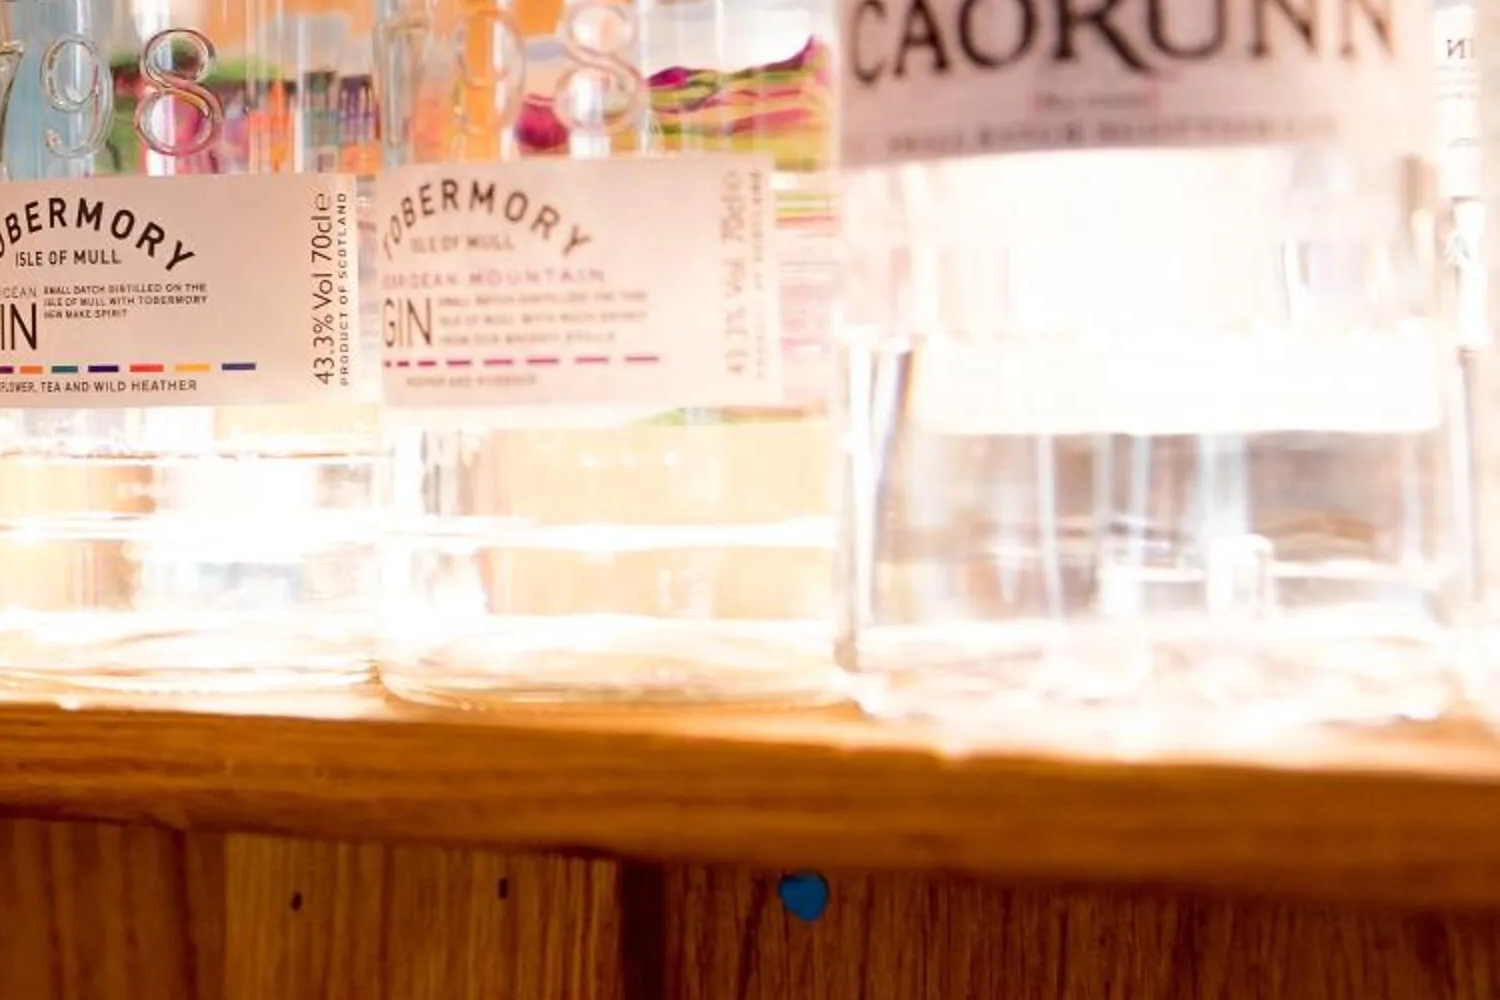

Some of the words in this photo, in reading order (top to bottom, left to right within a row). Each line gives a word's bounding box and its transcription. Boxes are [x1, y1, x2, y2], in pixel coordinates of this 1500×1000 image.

[382, 177, 593, 263] TOBERMORY
[337, 192, 350, 280] SCOTLAND
[15, 251, 43, 268] ISLE
[48, 250, 69, 266] OF
[73, 249, 123, 266] MULL
[108, 283, 163, 294] DISTILLED
[185, 282, 207, 293] THE
[109, 296, 135, 305] WITH
[138, 295, 208, 305] TOBERMORY
[311, 272, 334, 311] Vol
[338, 287, 350, 305] OF
[94, 308, 128, 319] SPIRIT
[382, 297, 434, 347] GIN
[311, 314, 335, 386] 43.3%
[338, 311, 350, 387] PRODUCT
[40, 381, 63, 393] TEA
[65, 381, 89, 393] AND
[93, 380, 127, 392] WILD
[131, 379, 197, 392] HEATHER
